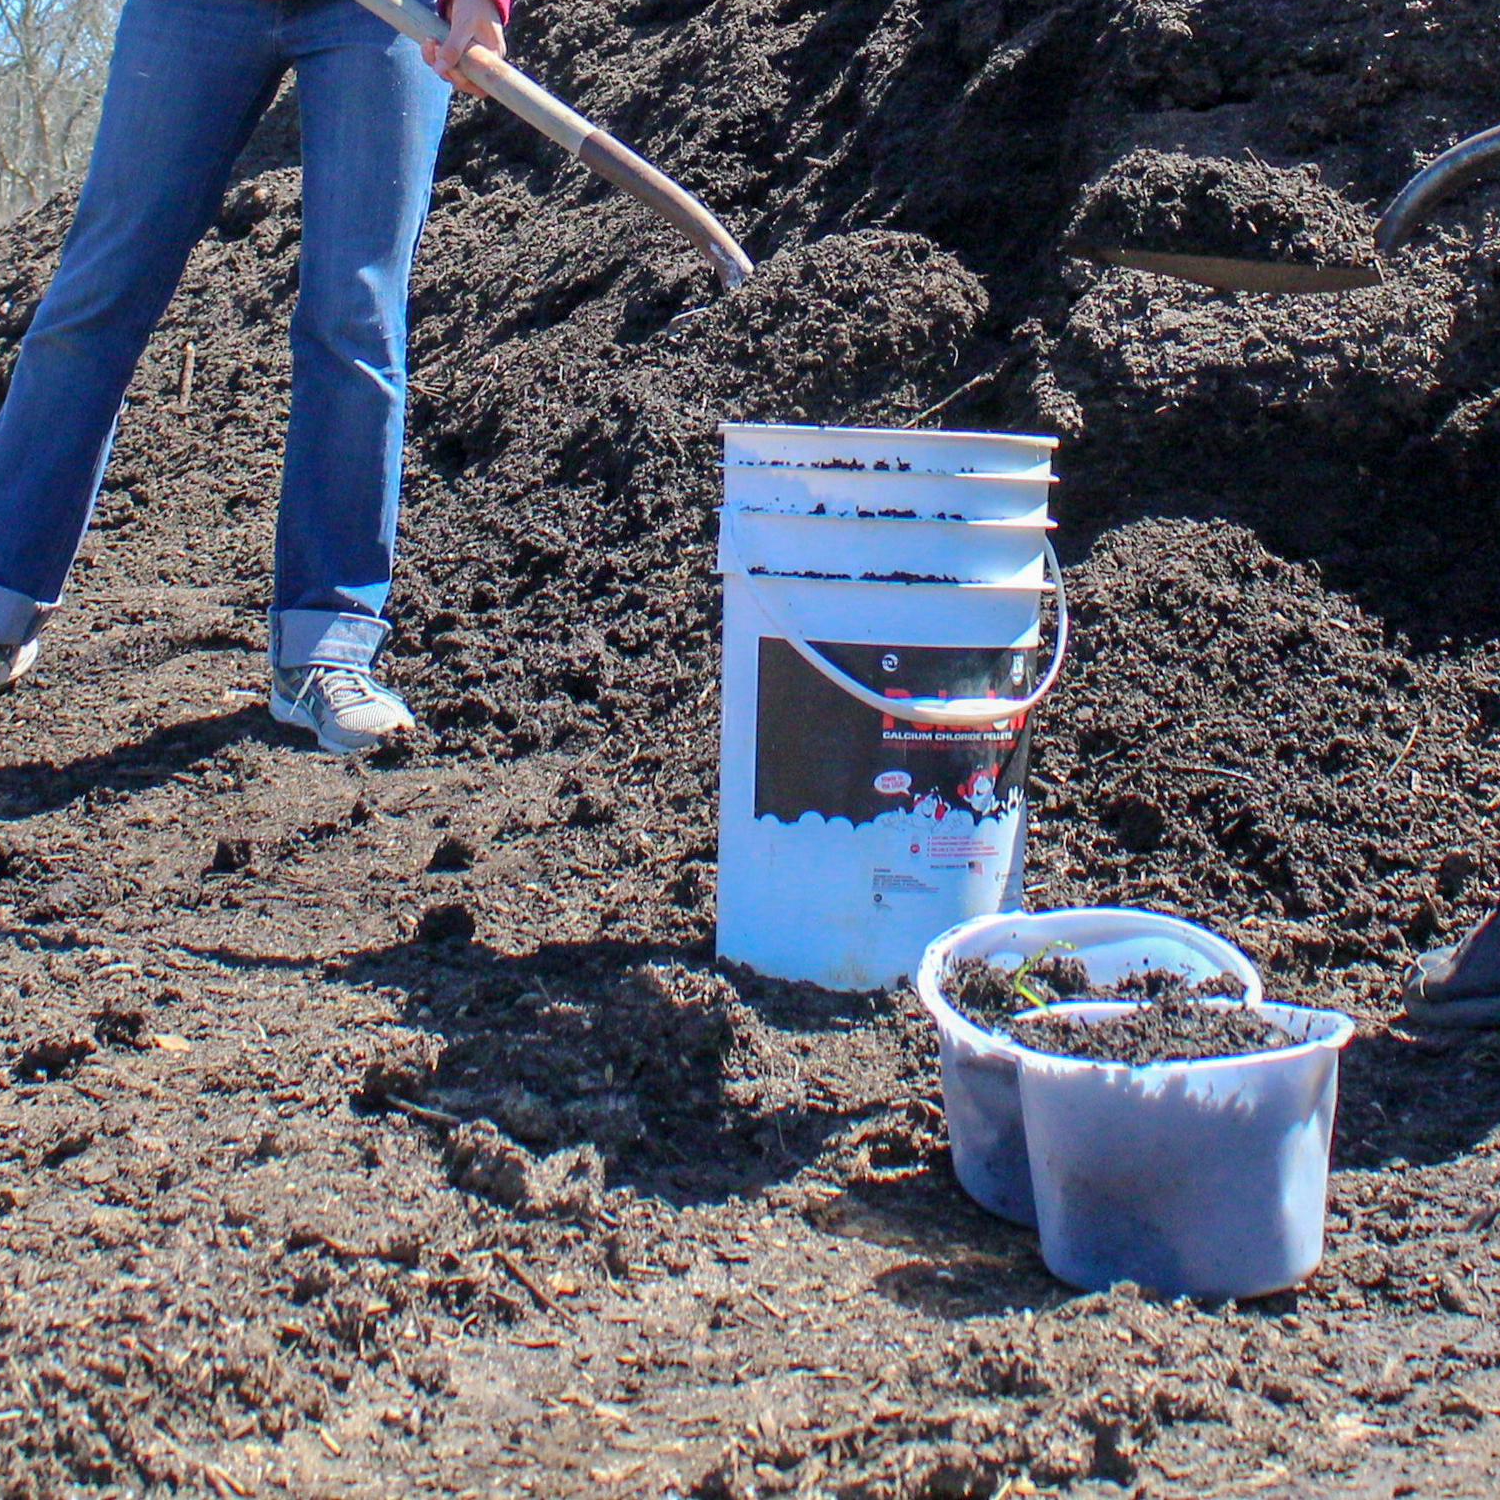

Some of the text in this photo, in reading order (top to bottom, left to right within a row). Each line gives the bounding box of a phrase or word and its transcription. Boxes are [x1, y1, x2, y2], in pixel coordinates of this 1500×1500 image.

[882, 731, 1013, 741] CALCIUM CHLORIDE PELLETS
